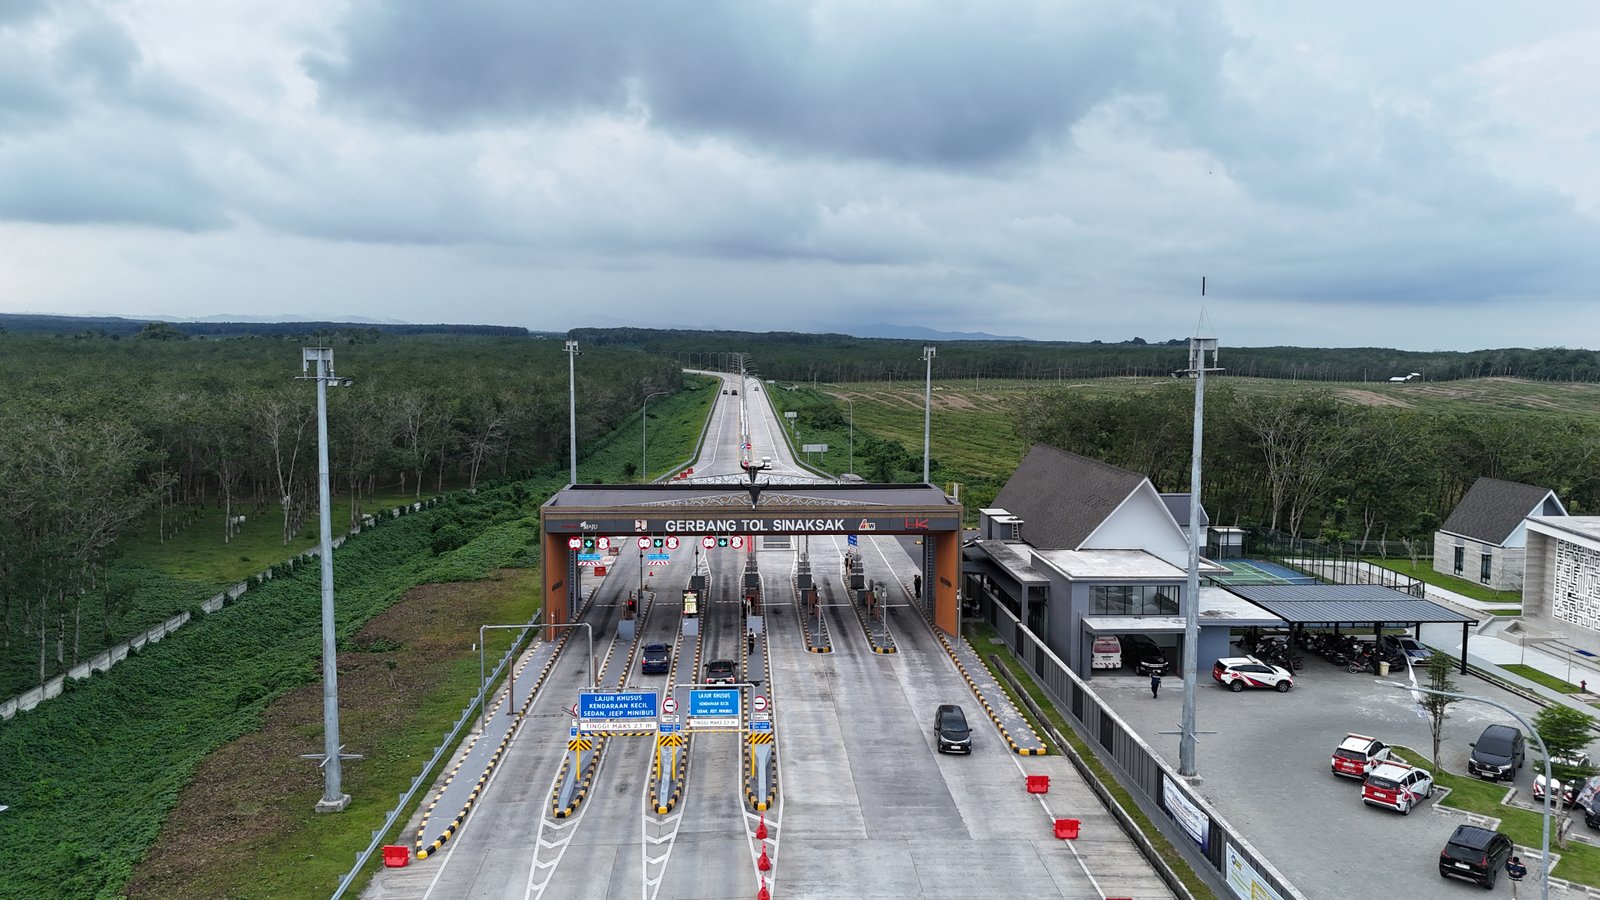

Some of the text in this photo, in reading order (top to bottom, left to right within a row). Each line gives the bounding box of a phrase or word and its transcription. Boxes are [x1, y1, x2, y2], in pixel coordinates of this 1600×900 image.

[665, 519, 737, 532] GERBANG
[741, 519, 768, 532] TOL
[772, 519, 845, 532] SINAKSAK
